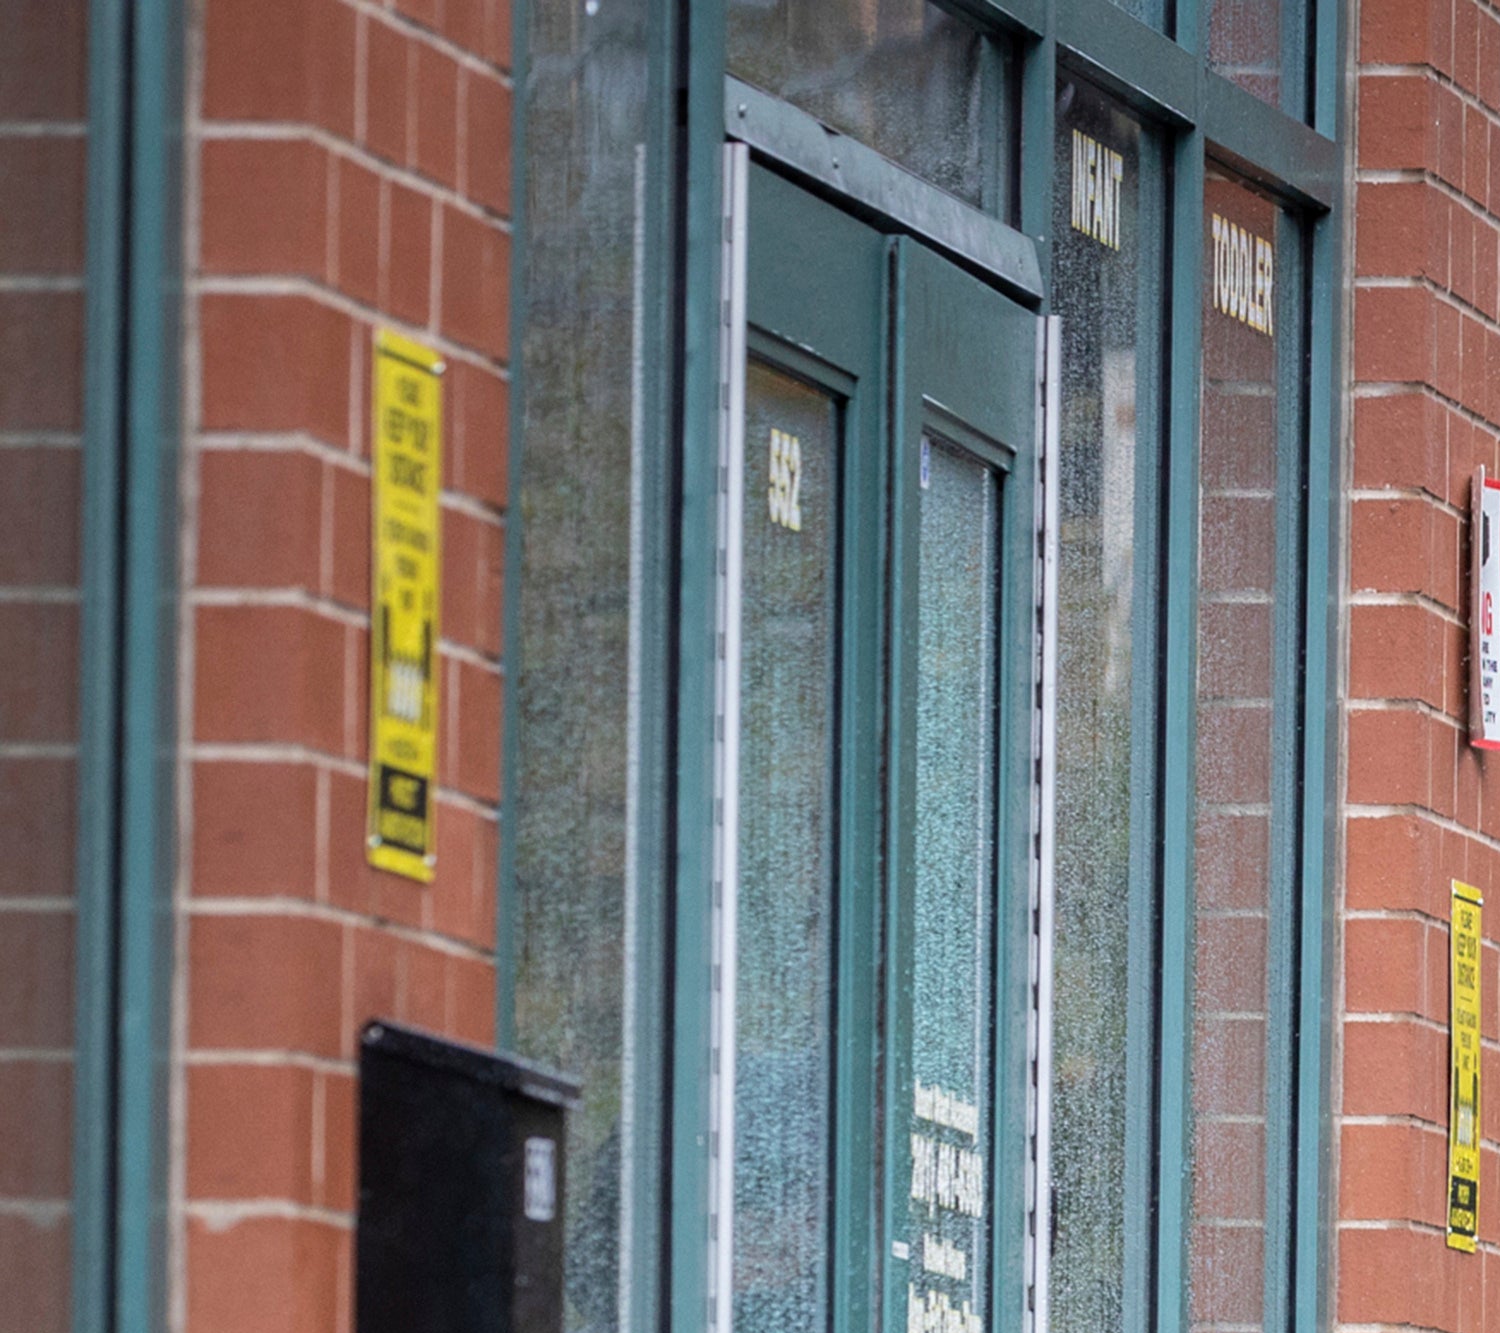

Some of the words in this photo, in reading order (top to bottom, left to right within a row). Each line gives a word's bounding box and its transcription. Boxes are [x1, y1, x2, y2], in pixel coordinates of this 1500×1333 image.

[1072, 128, 1123, 251] INFANT
[1211, 212, 1275, 338] TODDLER
[769, 429, 803, 532] 552
